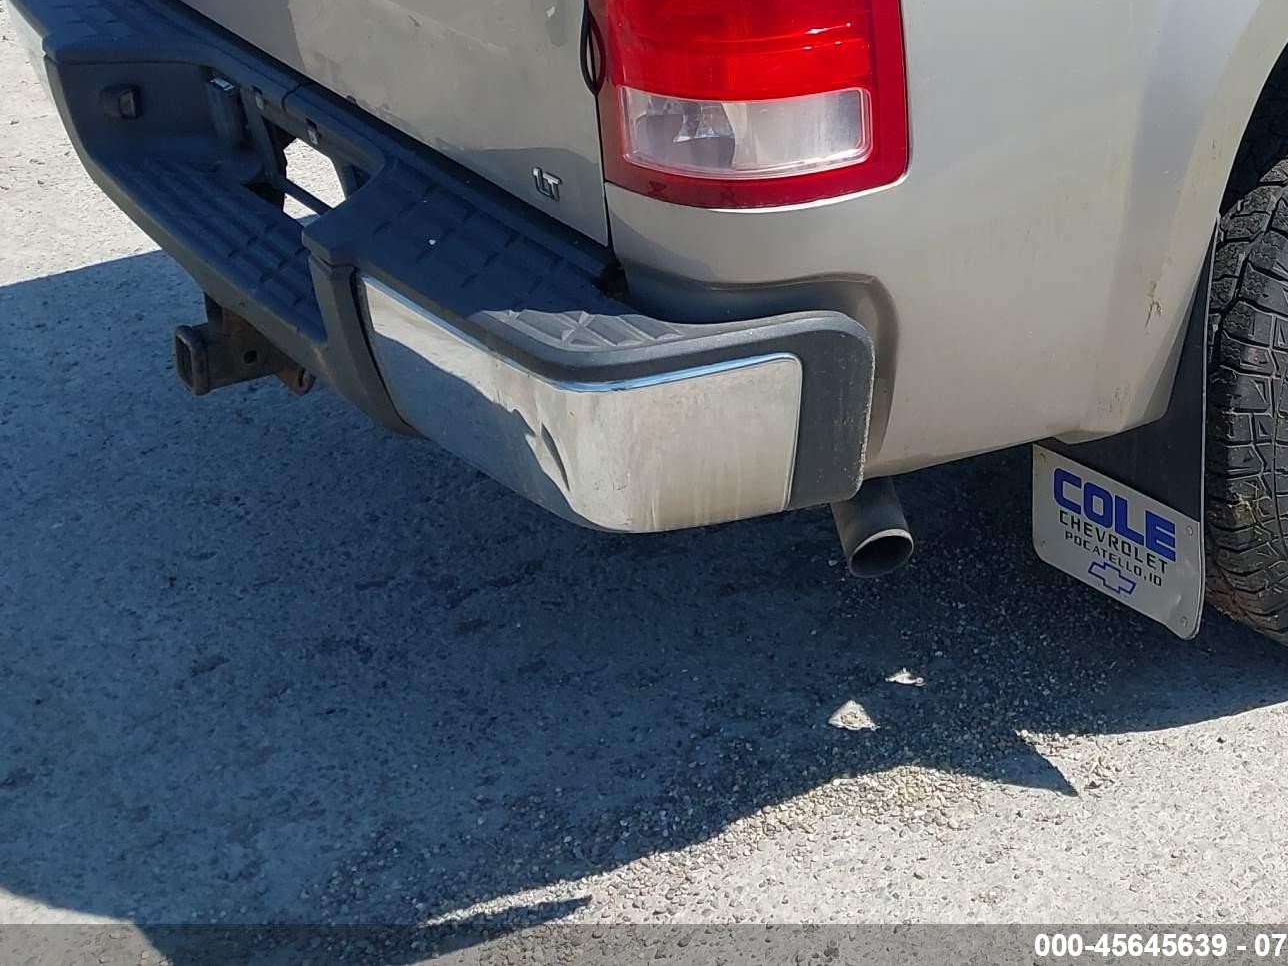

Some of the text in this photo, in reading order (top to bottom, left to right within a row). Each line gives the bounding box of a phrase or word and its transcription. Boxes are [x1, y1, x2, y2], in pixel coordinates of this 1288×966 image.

[532, 167, 562, 203] LT
[1053, 467, 1176, 562] COLE
[1059, 509, 1168, 574] CHEVROLET
